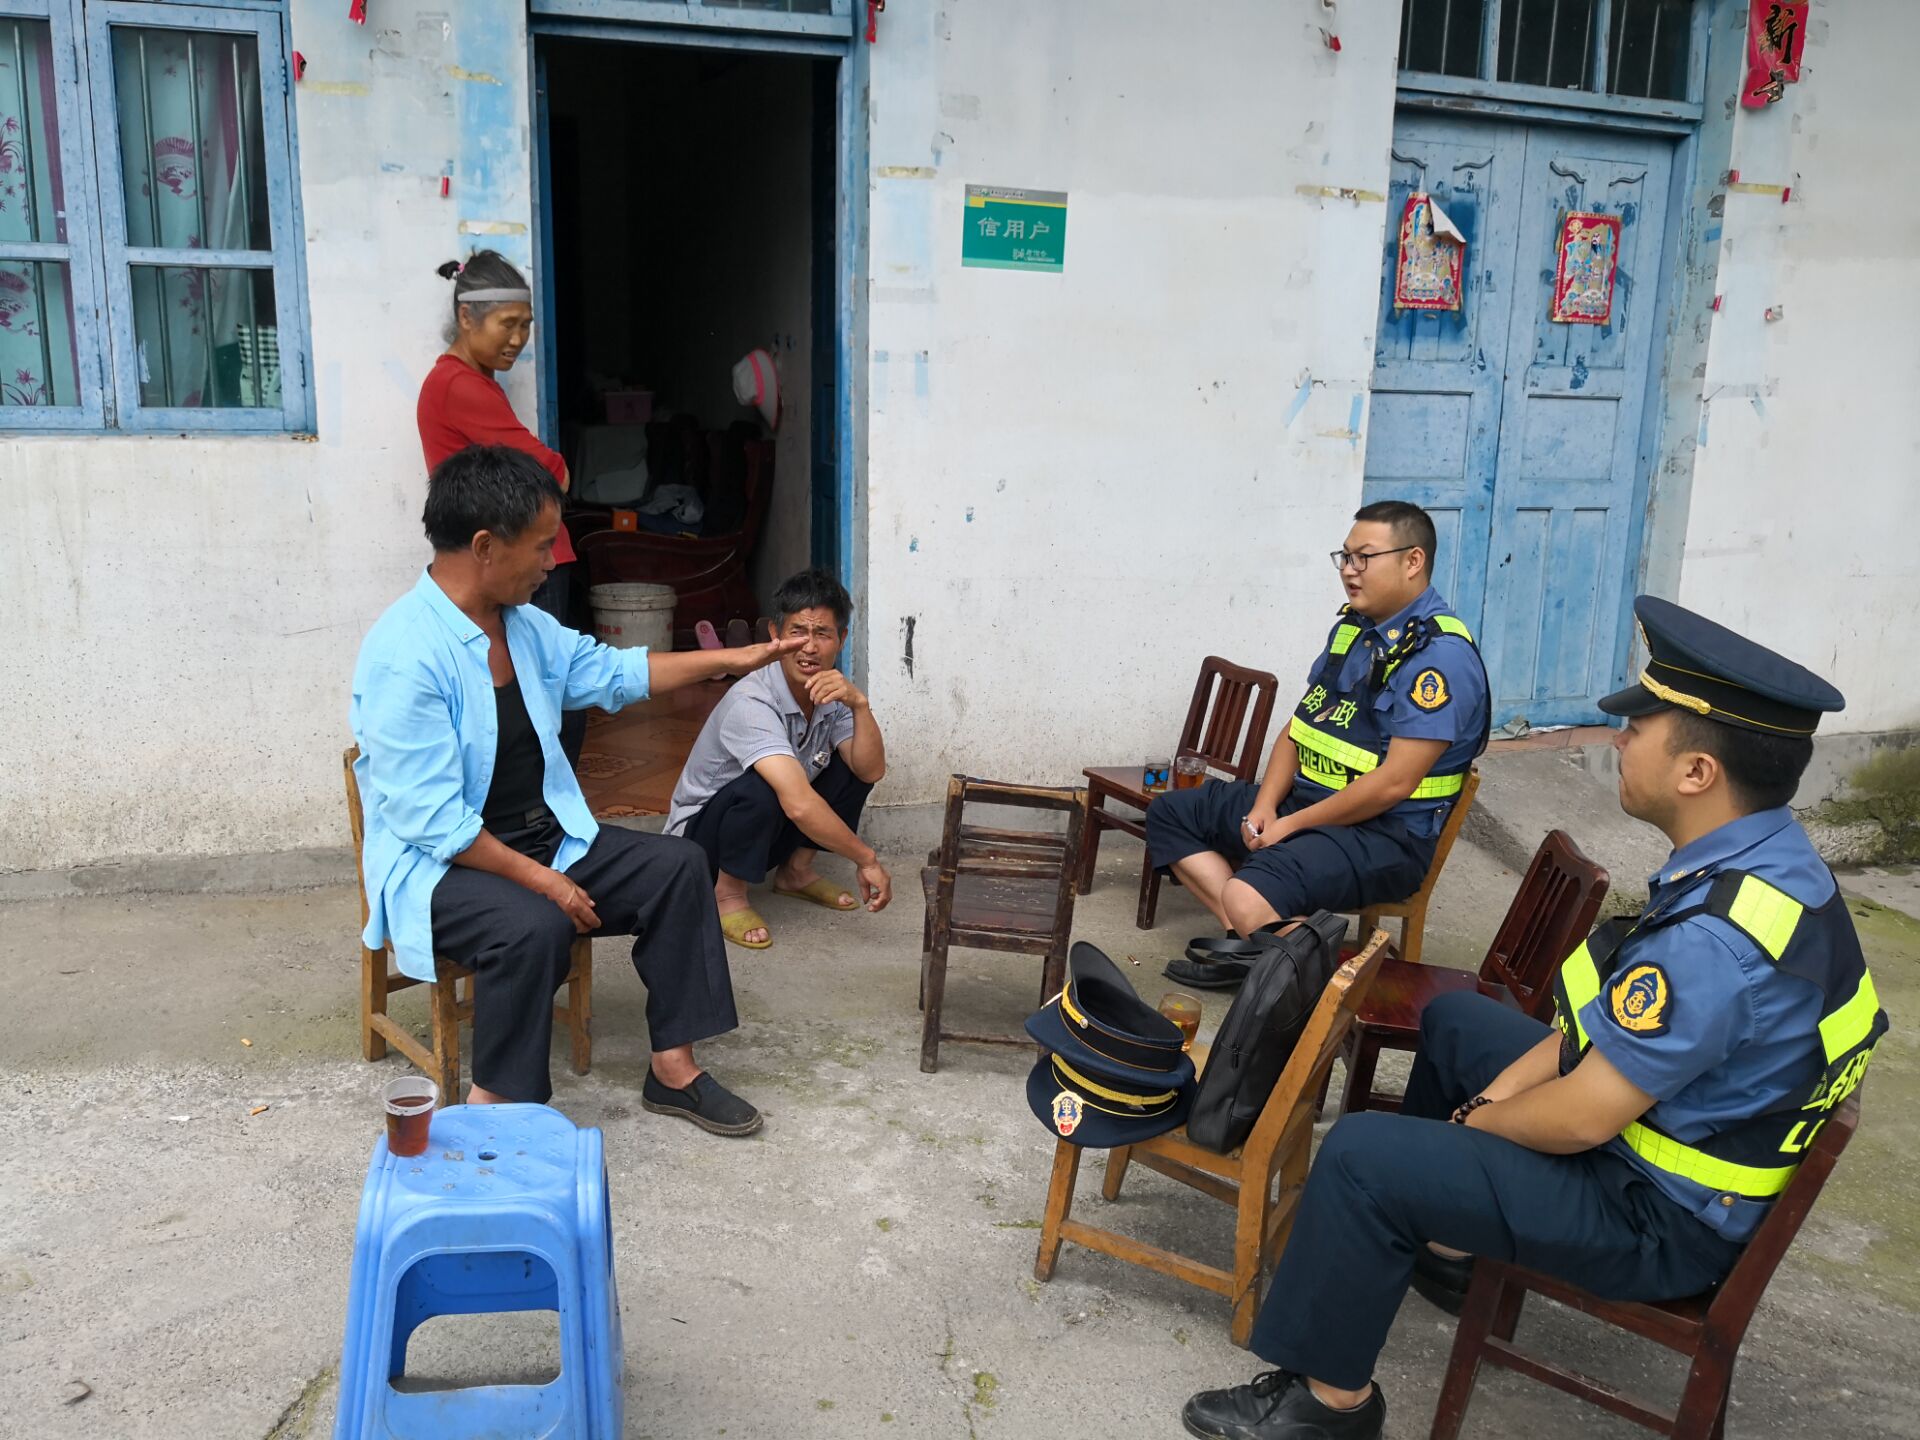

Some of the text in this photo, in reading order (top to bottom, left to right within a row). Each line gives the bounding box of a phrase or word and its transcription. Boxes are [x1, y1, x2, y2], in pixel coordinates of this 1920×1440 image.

[977, 216, 1050, 240] 信用户
[1301, 684, 1359, 729] 路政
